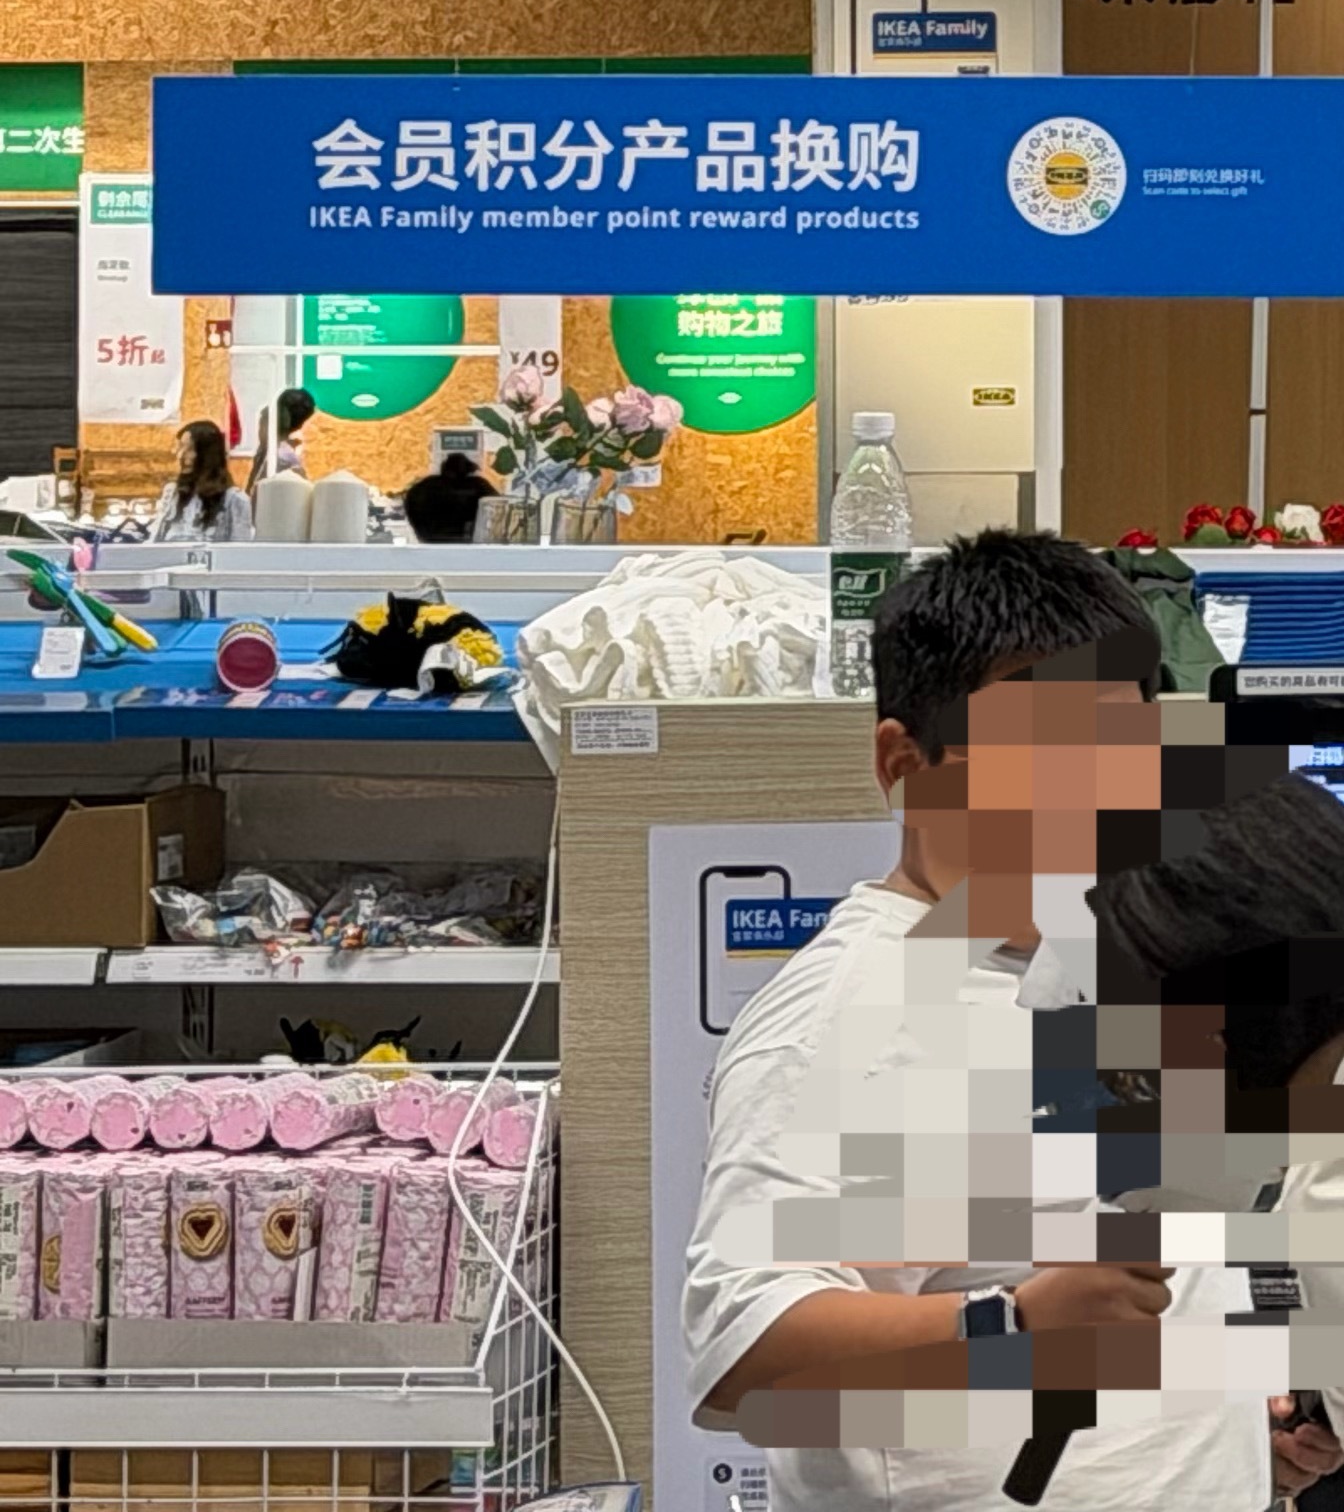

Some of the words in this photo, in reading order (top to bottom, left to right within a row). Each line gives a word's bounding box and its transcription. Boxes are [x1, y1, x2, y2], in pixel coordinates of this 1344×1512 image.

[877, 20, 921, 36] IKEA
[926, 20, 988, 38] Family
[0, 125, 85, 155] 二次生
[312, 118, 920, 193] 会员积分产品换购
[310, 206, 372, 228] IKEA
[381, 205, 474, 234] Family
[482, 205, 600, 228] member
[607, 205, 681, 234] point
[689, 205, 787, 228] reward
[796, 205, 919, 234] products
[733, 910, 783, 928] IKEA
